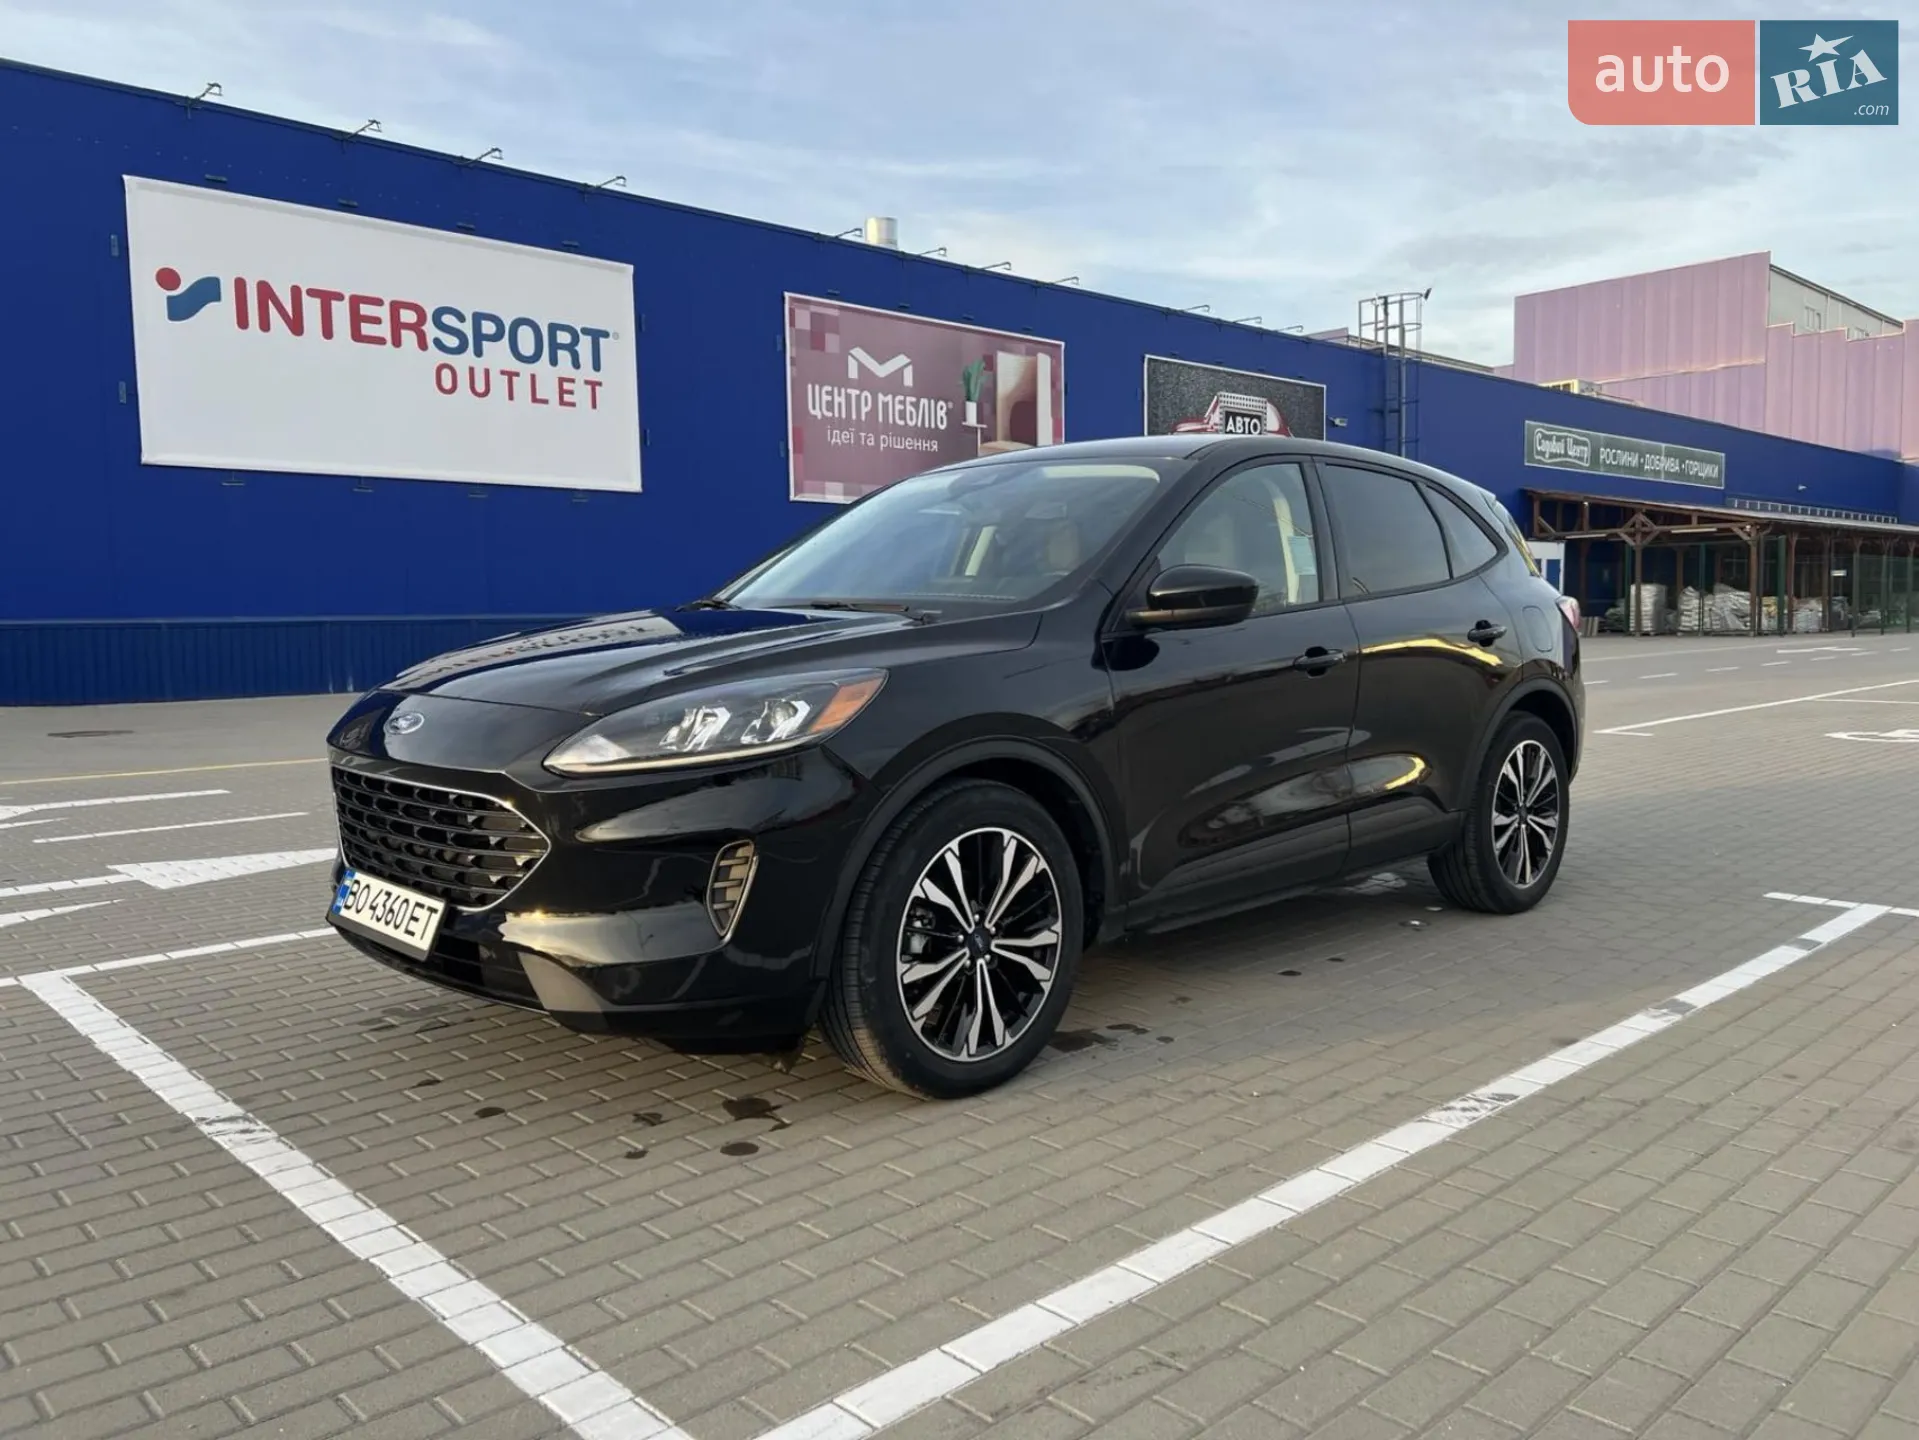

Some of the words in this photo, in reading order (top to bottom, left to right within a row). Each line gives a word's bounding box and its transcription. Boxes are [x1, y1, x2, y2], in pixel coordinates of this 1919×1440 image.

[234, 277, 611, 373] INTERSPORT
[435, 363, 603, 410] OUTLET
[807, 383, 872, 421] ЦЕНТР
[878, 392, 947, 430] МЕБЛІВ
[1226, 415, 1261, 434] АВТО
[827, 426, 855, 446] ідеї
[859, 432, 875, 446] та
[880, 432, 938, 452] рішення
[1600, 447, 1639, 468] РОСЛИНИ
[1644, 454, 1680, 473] ДОБРИВА
[1685, 459, 1719, 479] ГОРЩИКИ
